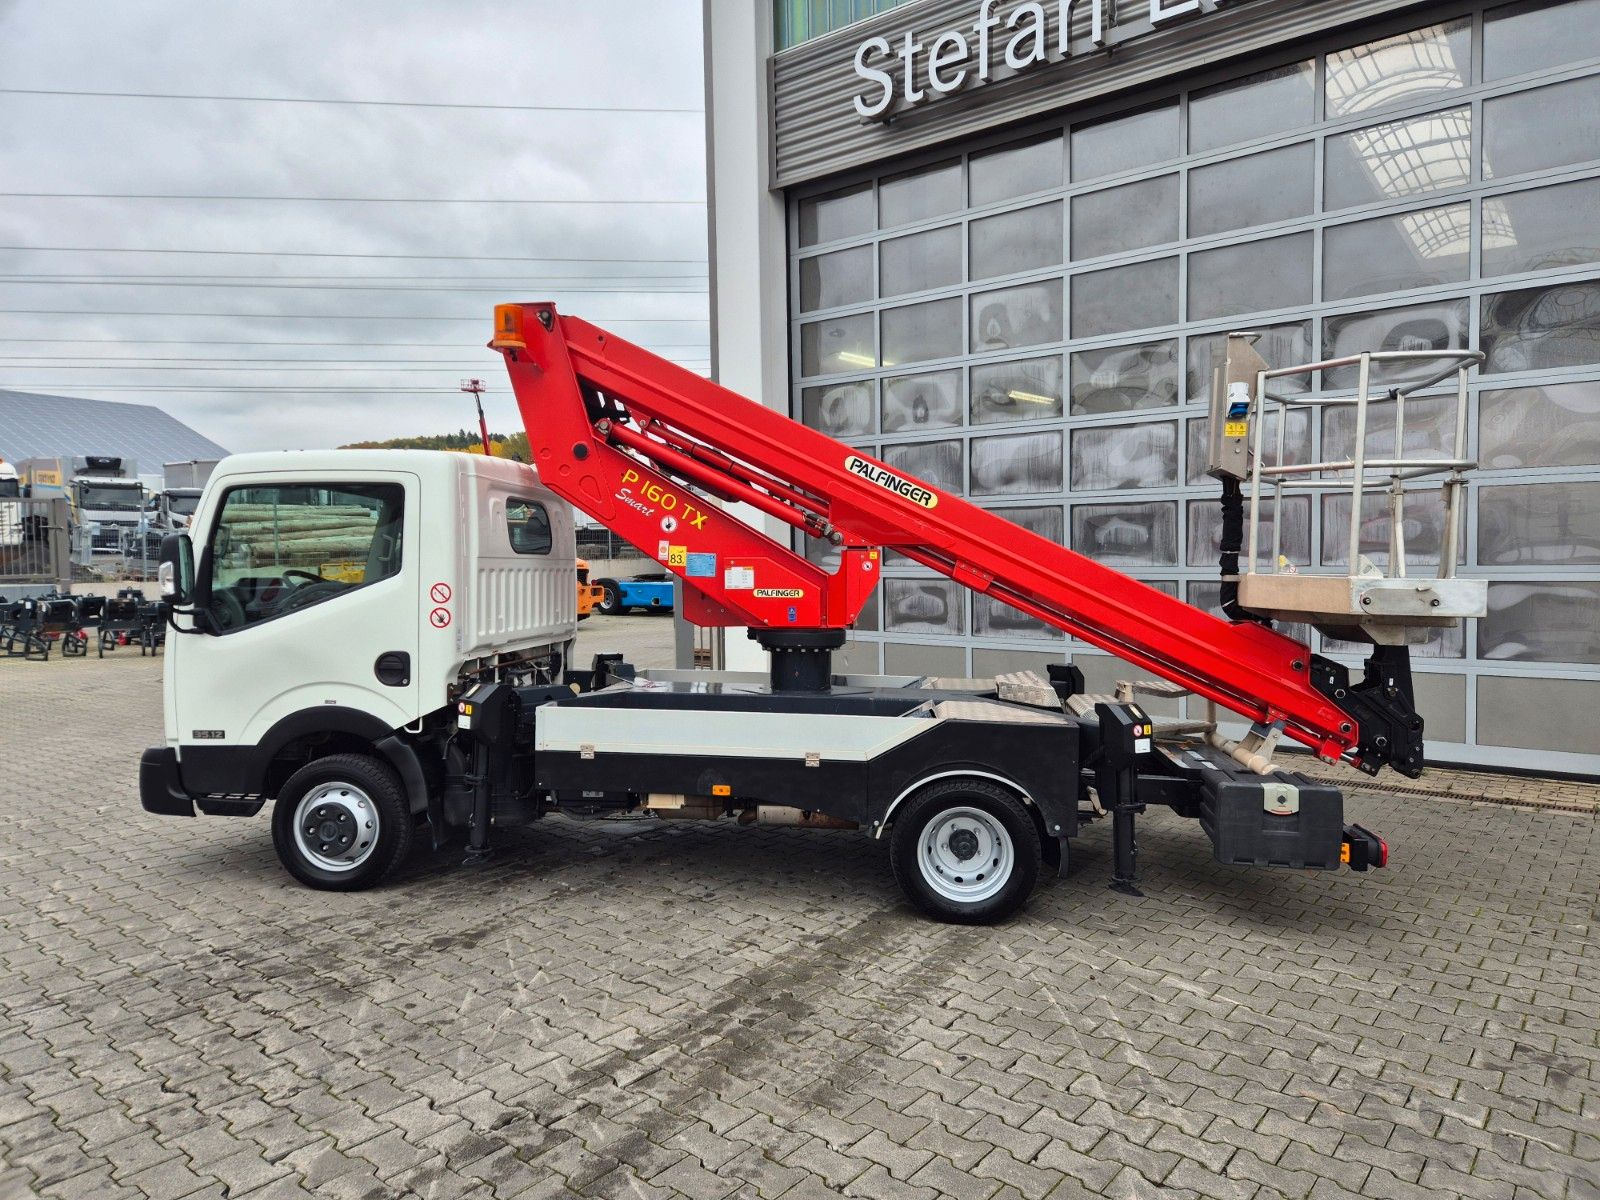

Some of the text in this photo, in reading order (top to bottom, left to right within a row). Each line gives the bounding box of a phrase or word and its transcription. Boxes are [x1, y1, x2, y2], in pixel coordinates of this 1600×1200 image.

[853, 0, 1101, 117] Stefan
[622, 468, 708, 530] P 160 TX
[849, 458, 932, 506] PALFINGER
[614, 487, 655, 517] Smart
[670, 554, 682, 564] 83
[756, 589, 800, 597] PALFINGER
